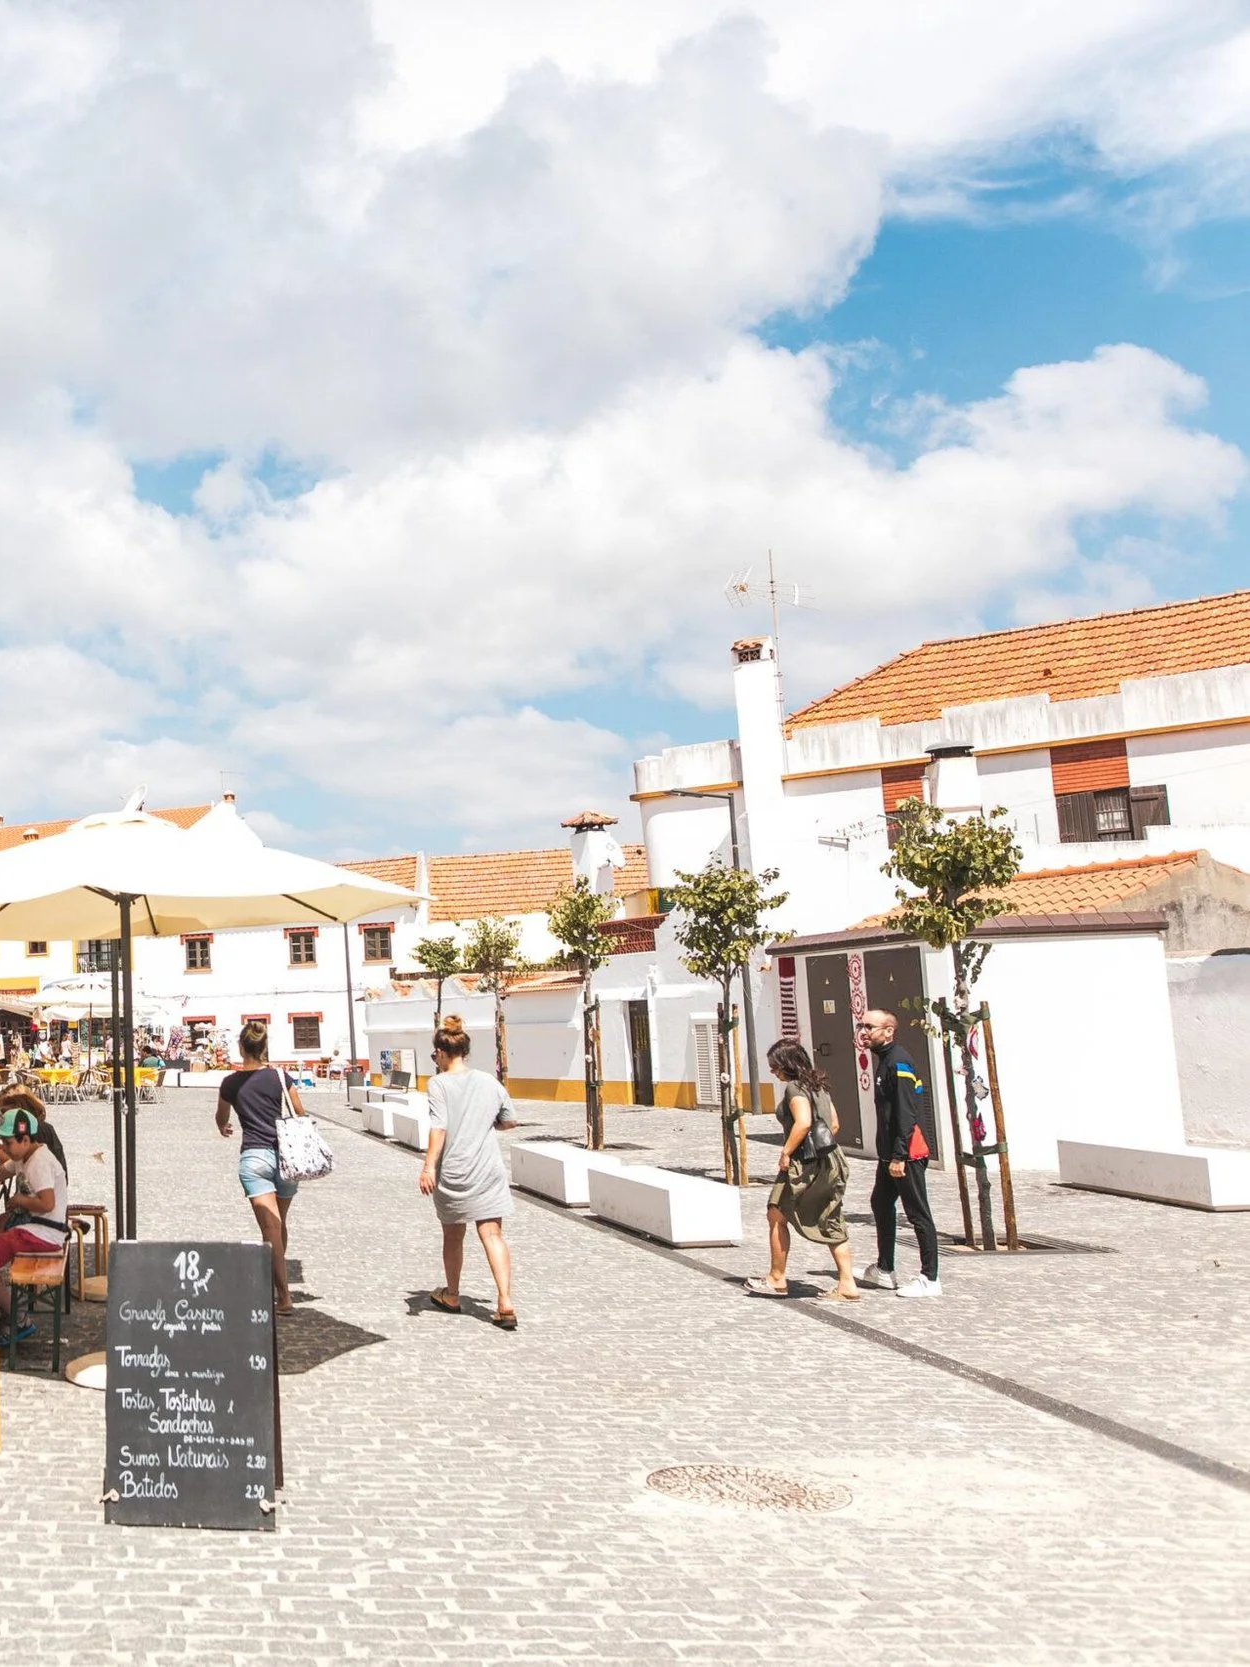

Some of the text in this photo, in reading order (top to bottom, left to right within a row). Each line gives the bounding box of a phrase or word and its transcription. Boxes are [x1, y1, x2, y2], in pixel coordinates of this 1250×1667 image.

[173, 1250, 200, 1280] 18
[119, 1298, 166, 1322] Granola
[174, 1299, 225, 1322] Caseira
[115, 1345, 171, 1369] Torradas
[159, 1388, 216, 1413] Tostinhas
[118, 1445, 161, 1467] Sumos
[167, 1444, 230, 1469] Naturais
[119, 1470, 179, 1499] Batidos
